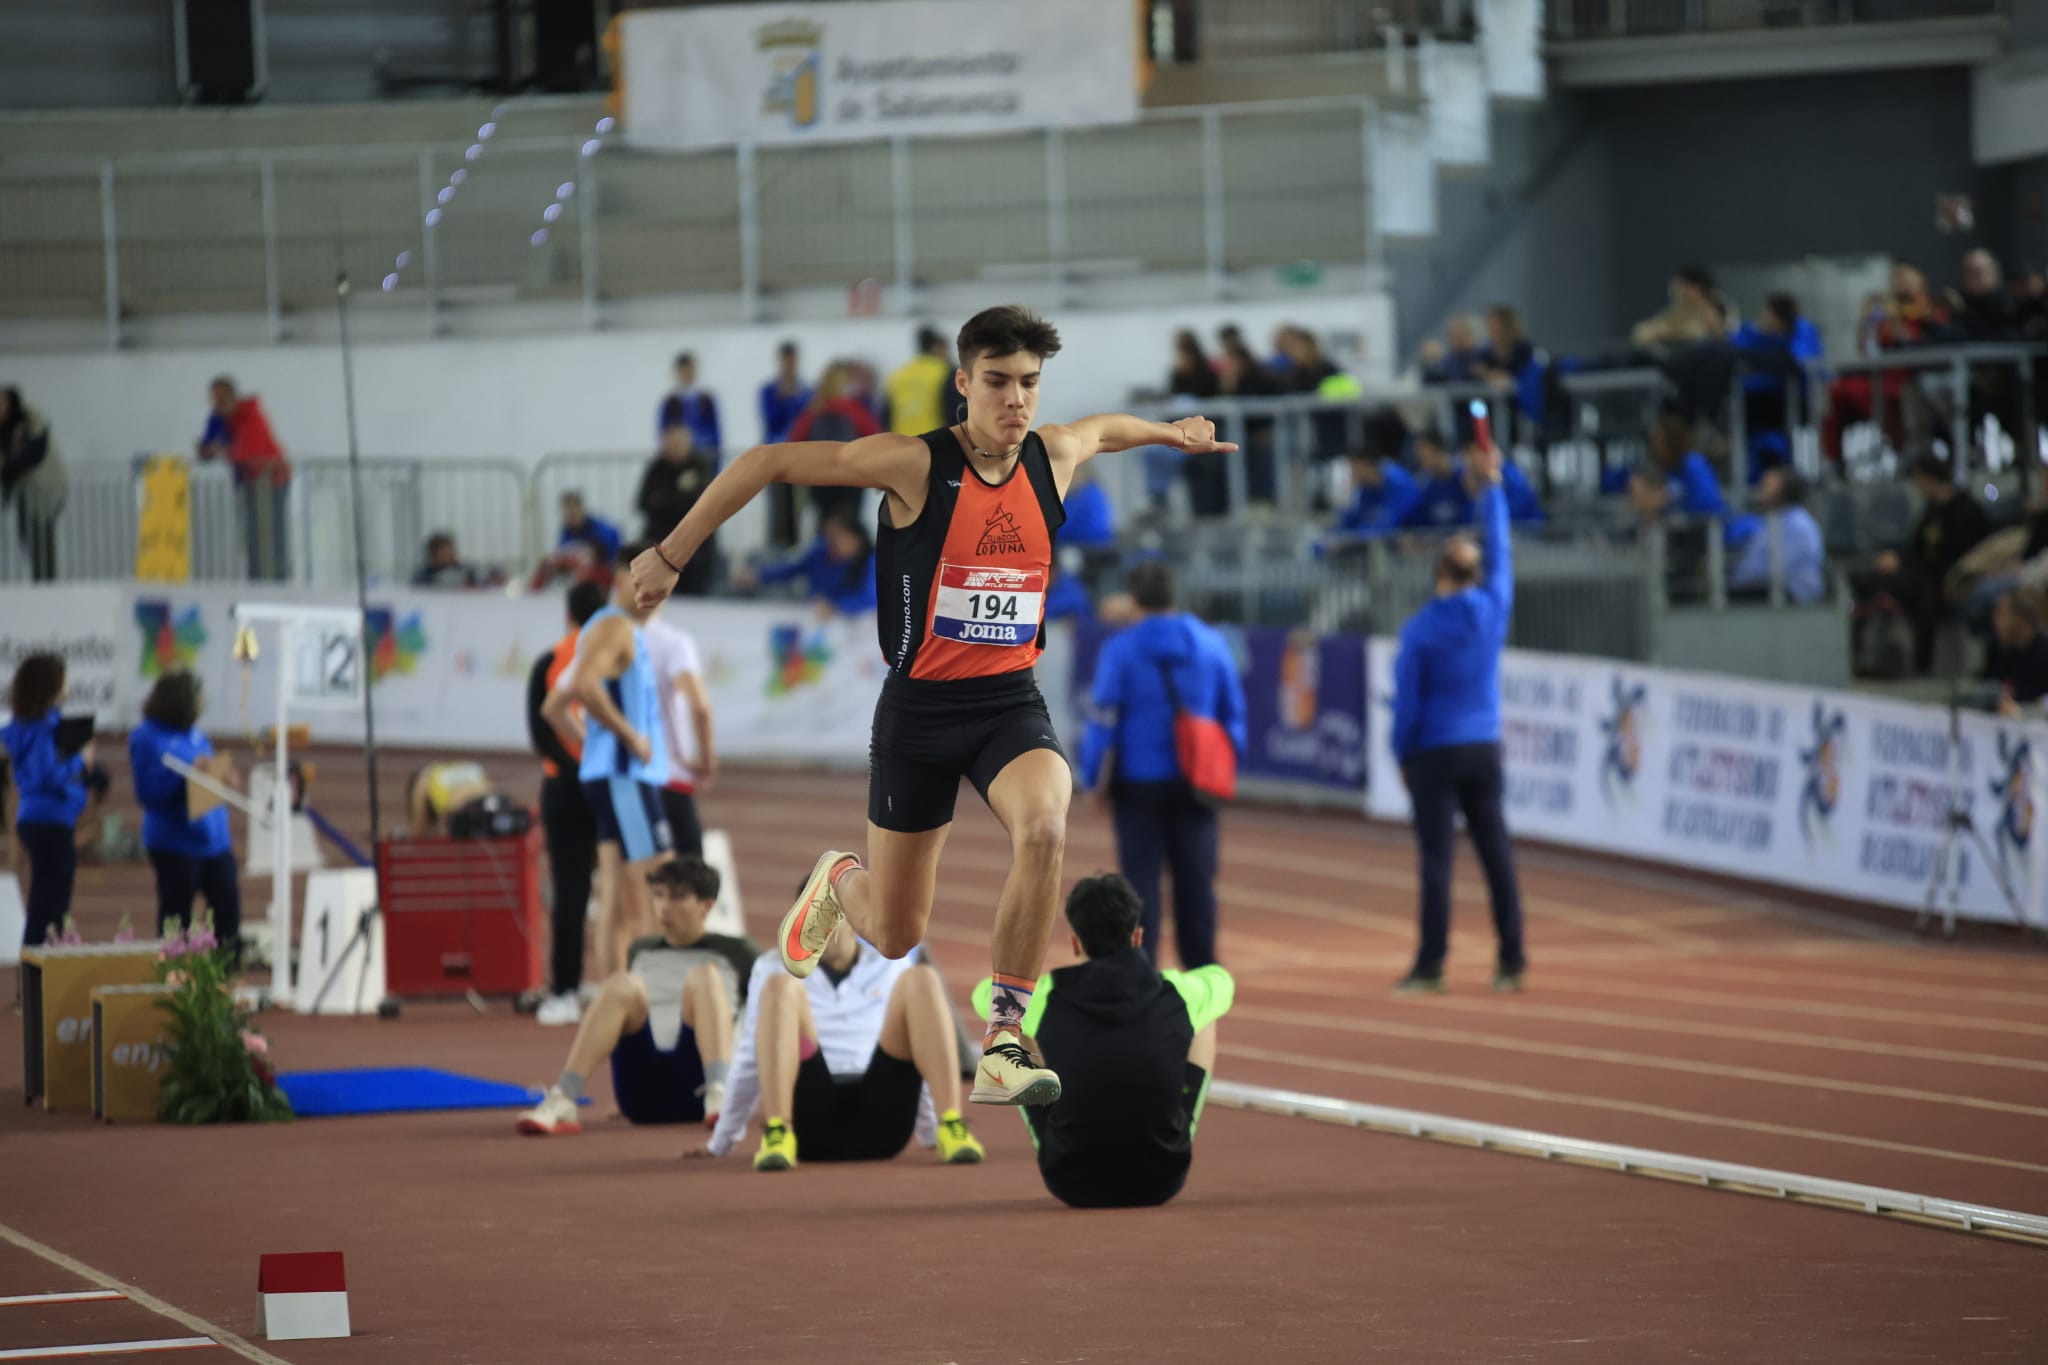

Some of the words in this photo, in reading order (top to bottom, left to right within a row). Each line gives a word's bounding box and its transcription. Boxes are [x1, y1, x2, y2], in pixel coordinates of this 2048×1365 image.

[968, 594, 1018, 621] 194
[959, 622, 1018, 641] Joma
[328, 634, 355, 689] 2
[316, 907, 330, 967] 1
